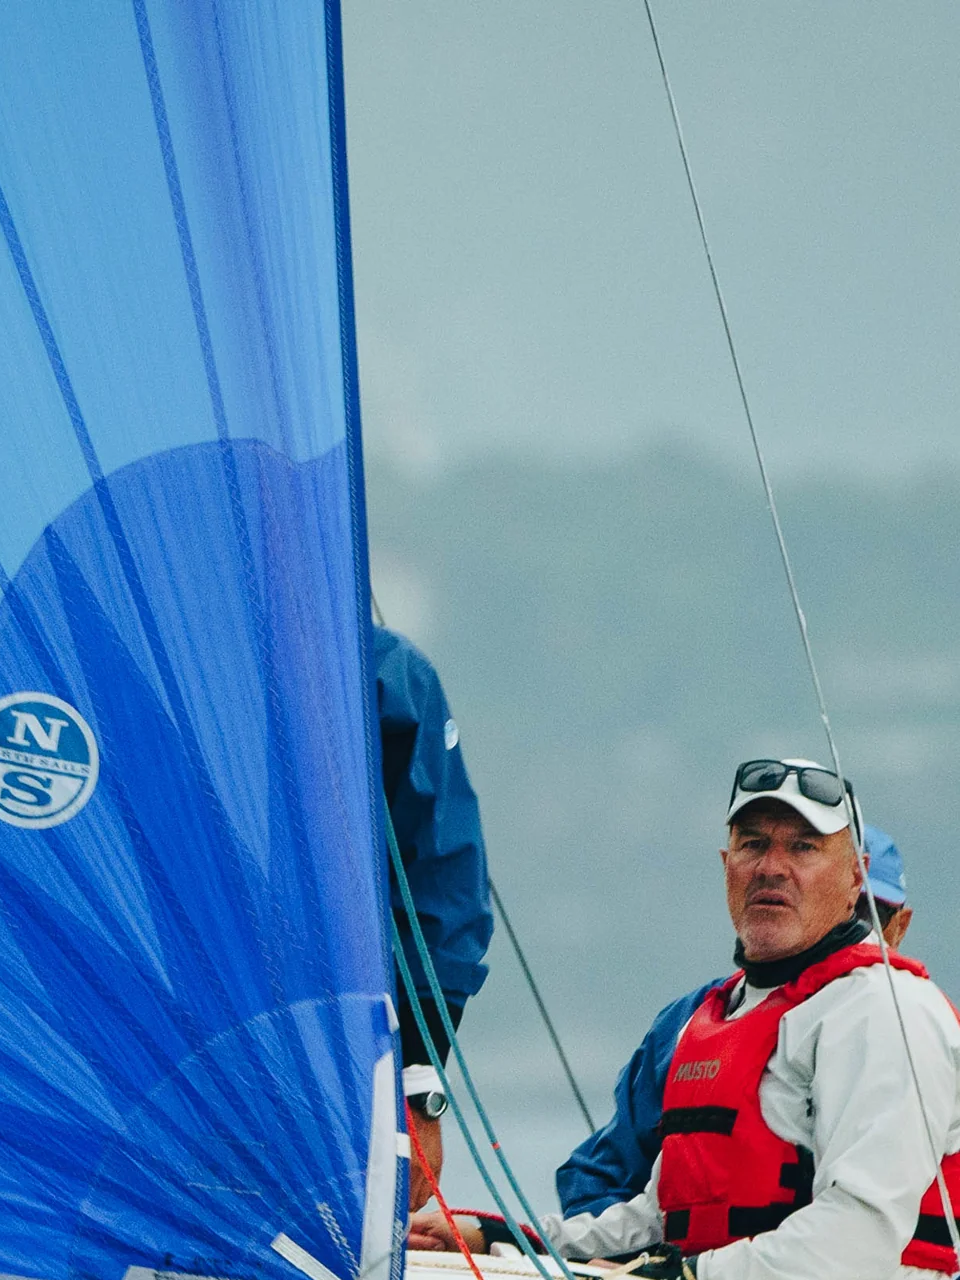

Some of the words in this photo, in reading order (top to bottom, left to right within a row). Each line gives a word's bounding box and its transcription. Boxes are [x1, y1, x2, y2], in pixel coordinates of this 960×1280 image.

[6, 709, 69, 752] N
[40, 758, 91, 774] SAILS
[0, 771, 53, 807] S
[672, 1059, 721, 1084] MUSTO
